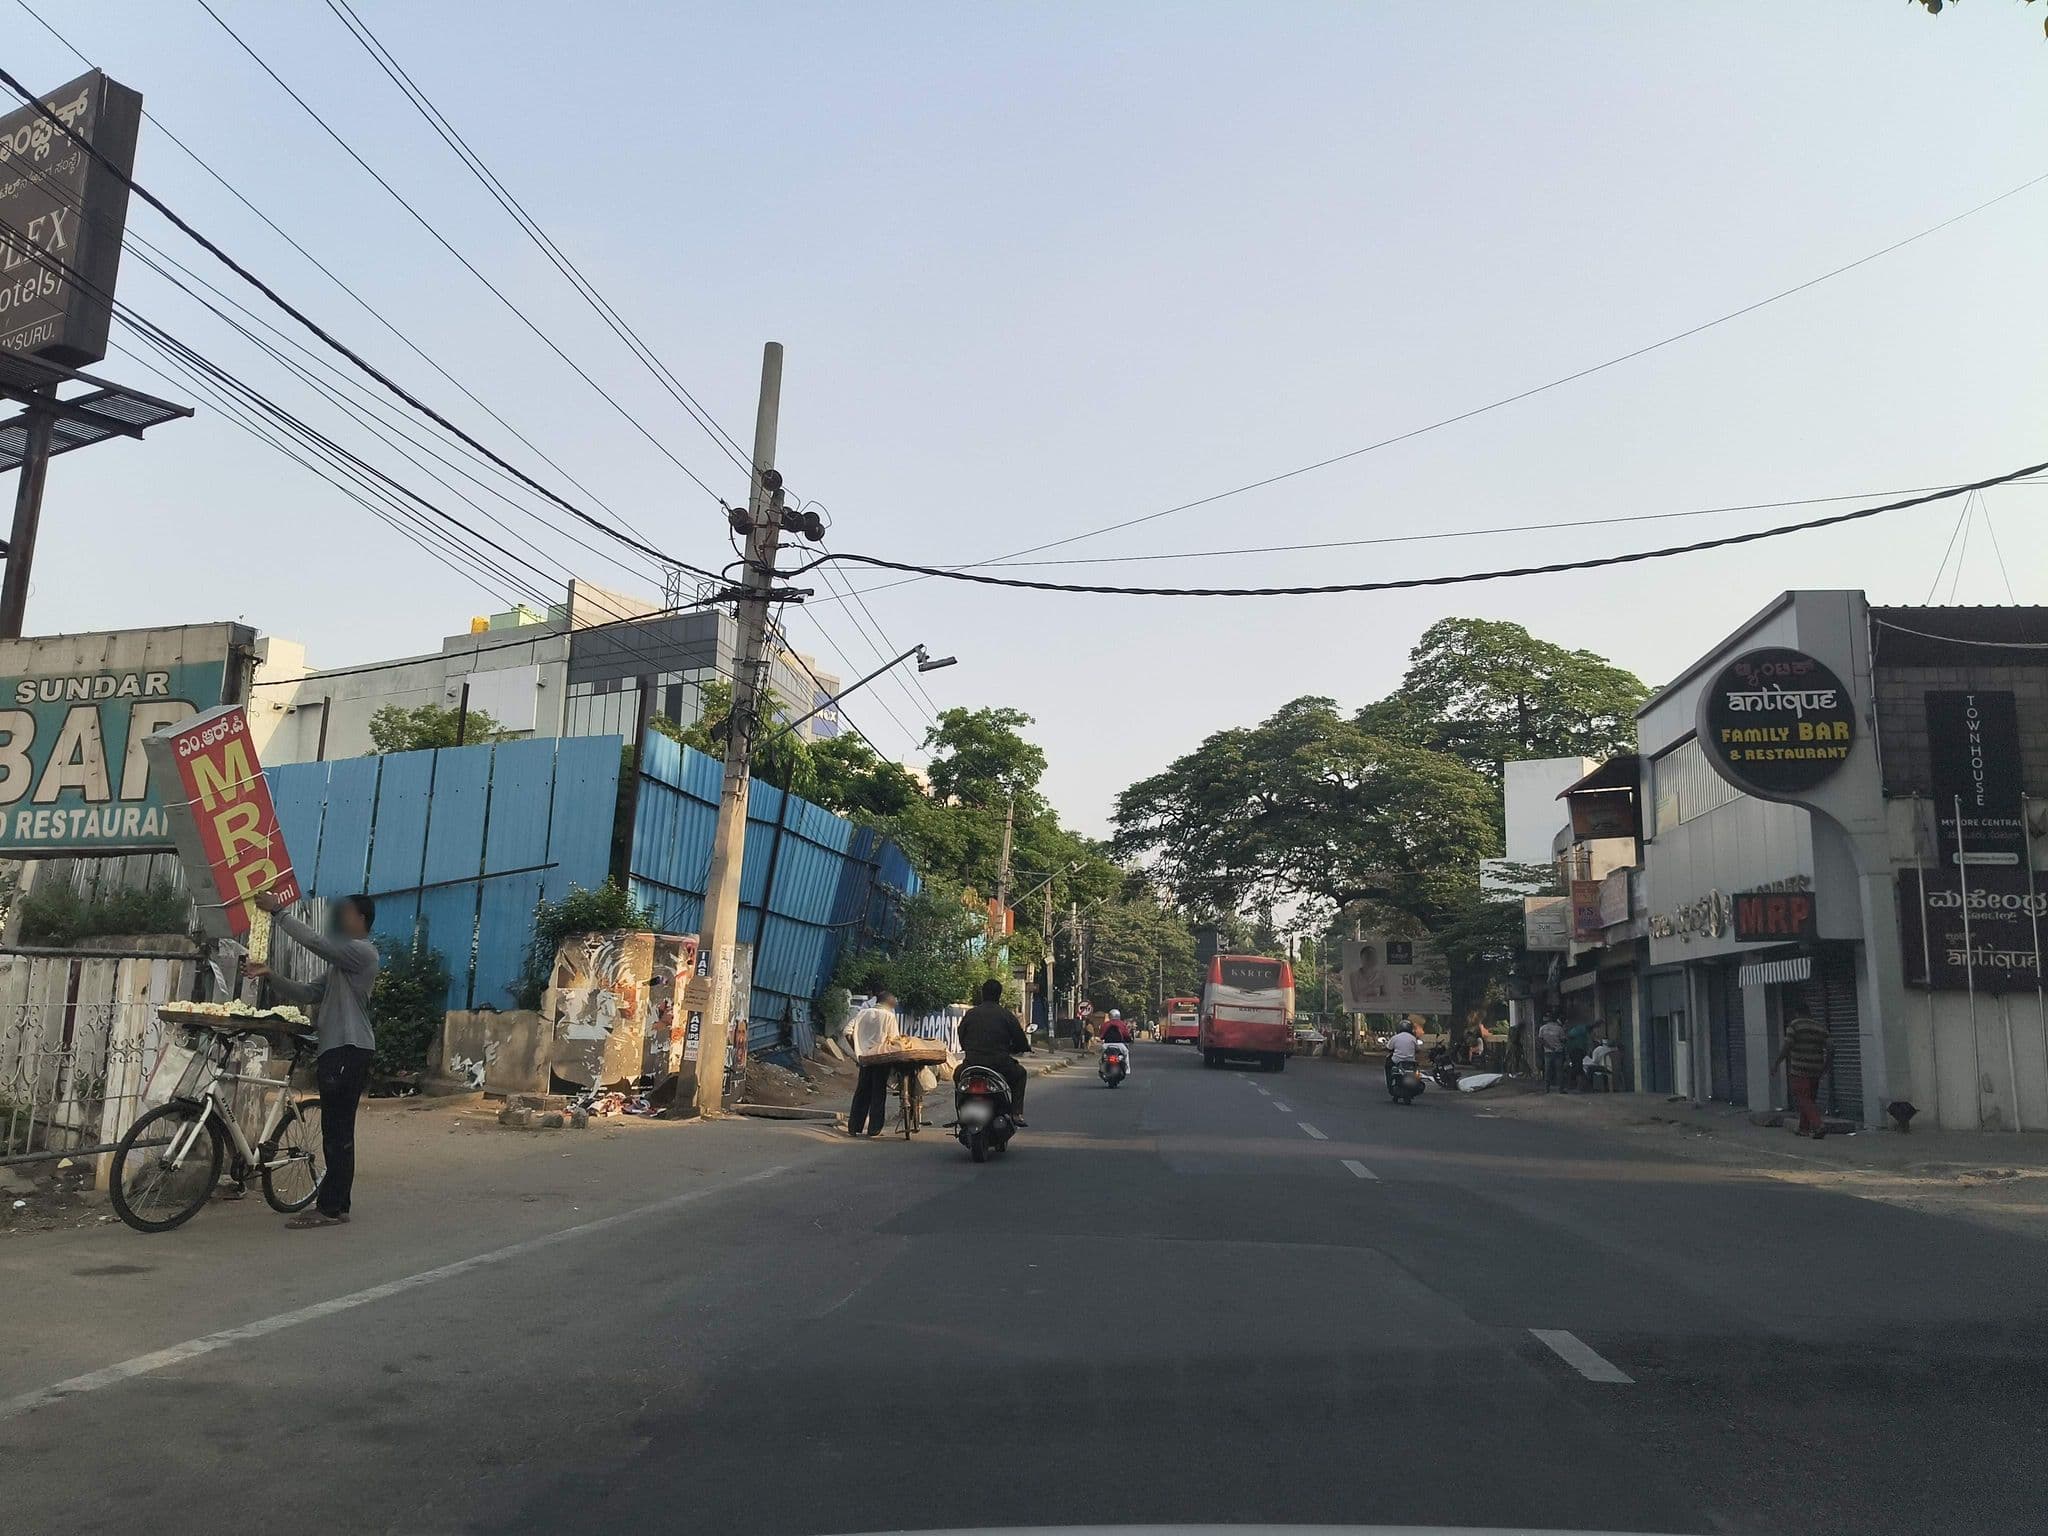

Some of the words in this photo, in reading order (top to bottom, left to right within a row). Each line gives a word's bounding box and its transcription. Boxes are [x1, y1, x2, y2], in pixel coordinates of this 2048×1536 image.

[15, 672, 170, 703] SUNDAR
[1726, 683, 1838, 719] antique
[1721, 727, 1790, 743] FAMILY
[1798, 721, 1849, 742] BAR
[1729, 749, 1742, 761] &
[1745, 746, 1848, 761] RESTAURANT
[1966, 695, 1985, 806] TOWNHOUSE
[1981, 818, 2023, 828] CENTRAL
[1739, 896, 1810, 935] MRP
